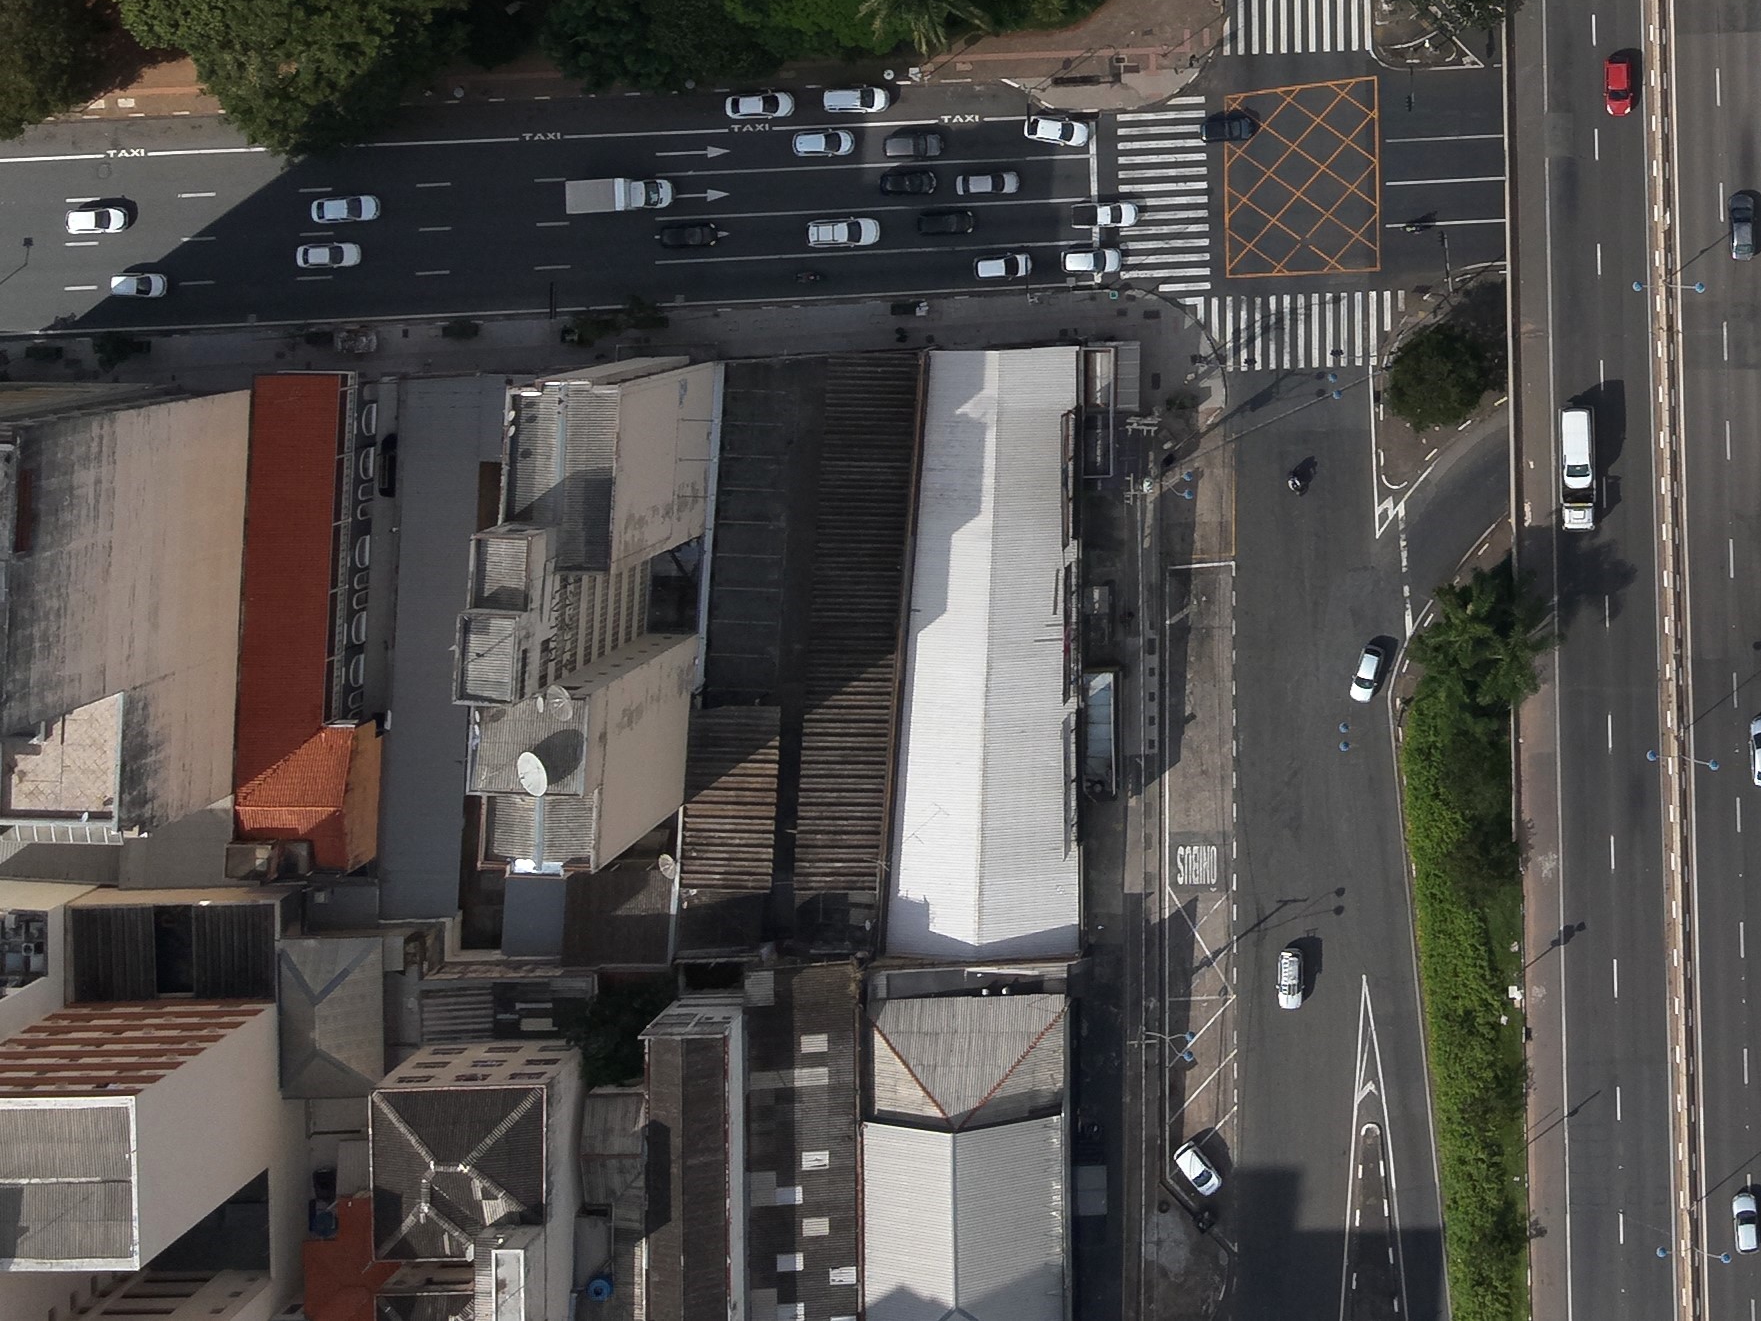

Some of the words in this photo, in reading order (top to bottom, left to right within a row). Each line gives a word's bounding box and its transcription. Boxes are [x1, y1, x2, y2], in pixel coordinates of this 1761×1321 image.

[941, 114, 980, 123] TAXI
[731, 123, 770, 133] TAXI
[522, 132, 562, 141] TAXI
[106, 148, 145, 158] TAXI
[1176, 845, 1218, 893] ÔNIBUS
